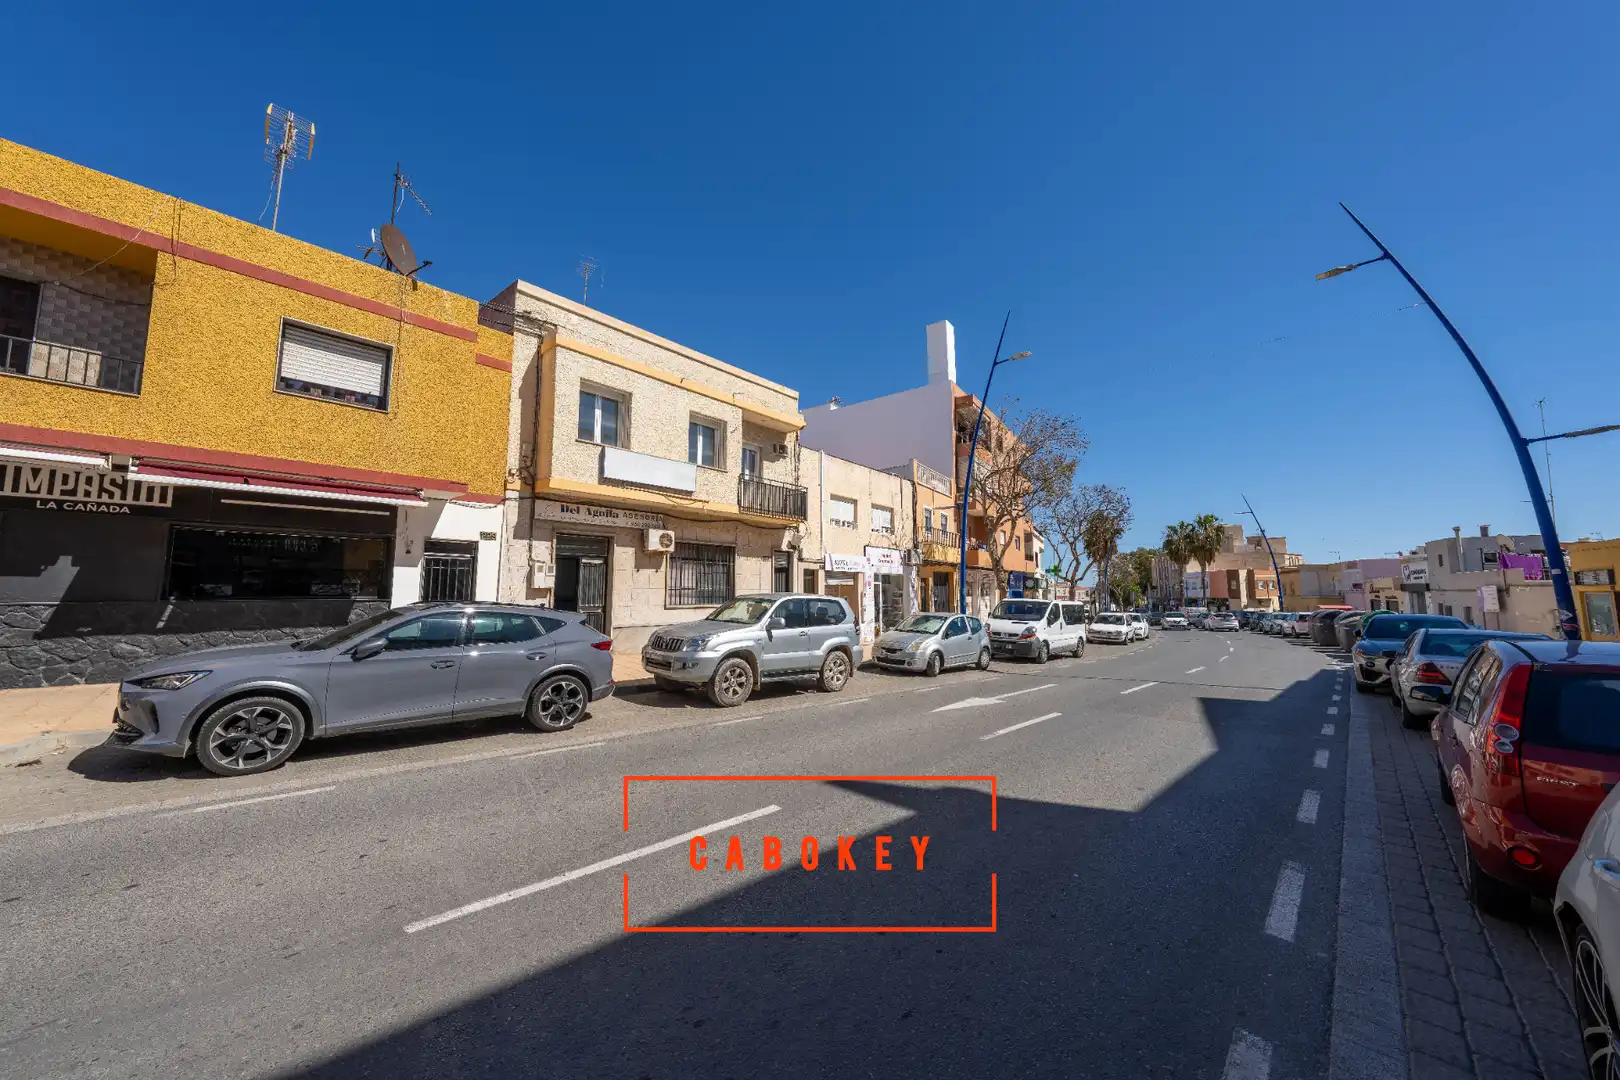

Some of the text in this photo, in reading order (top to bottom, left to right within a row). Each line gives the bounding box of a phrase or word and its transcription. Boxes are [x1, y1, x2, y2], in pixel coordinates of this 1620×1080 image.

[36, 500, 130, 514] LA CAÑADA
[560, 504, 581, 515] Del
